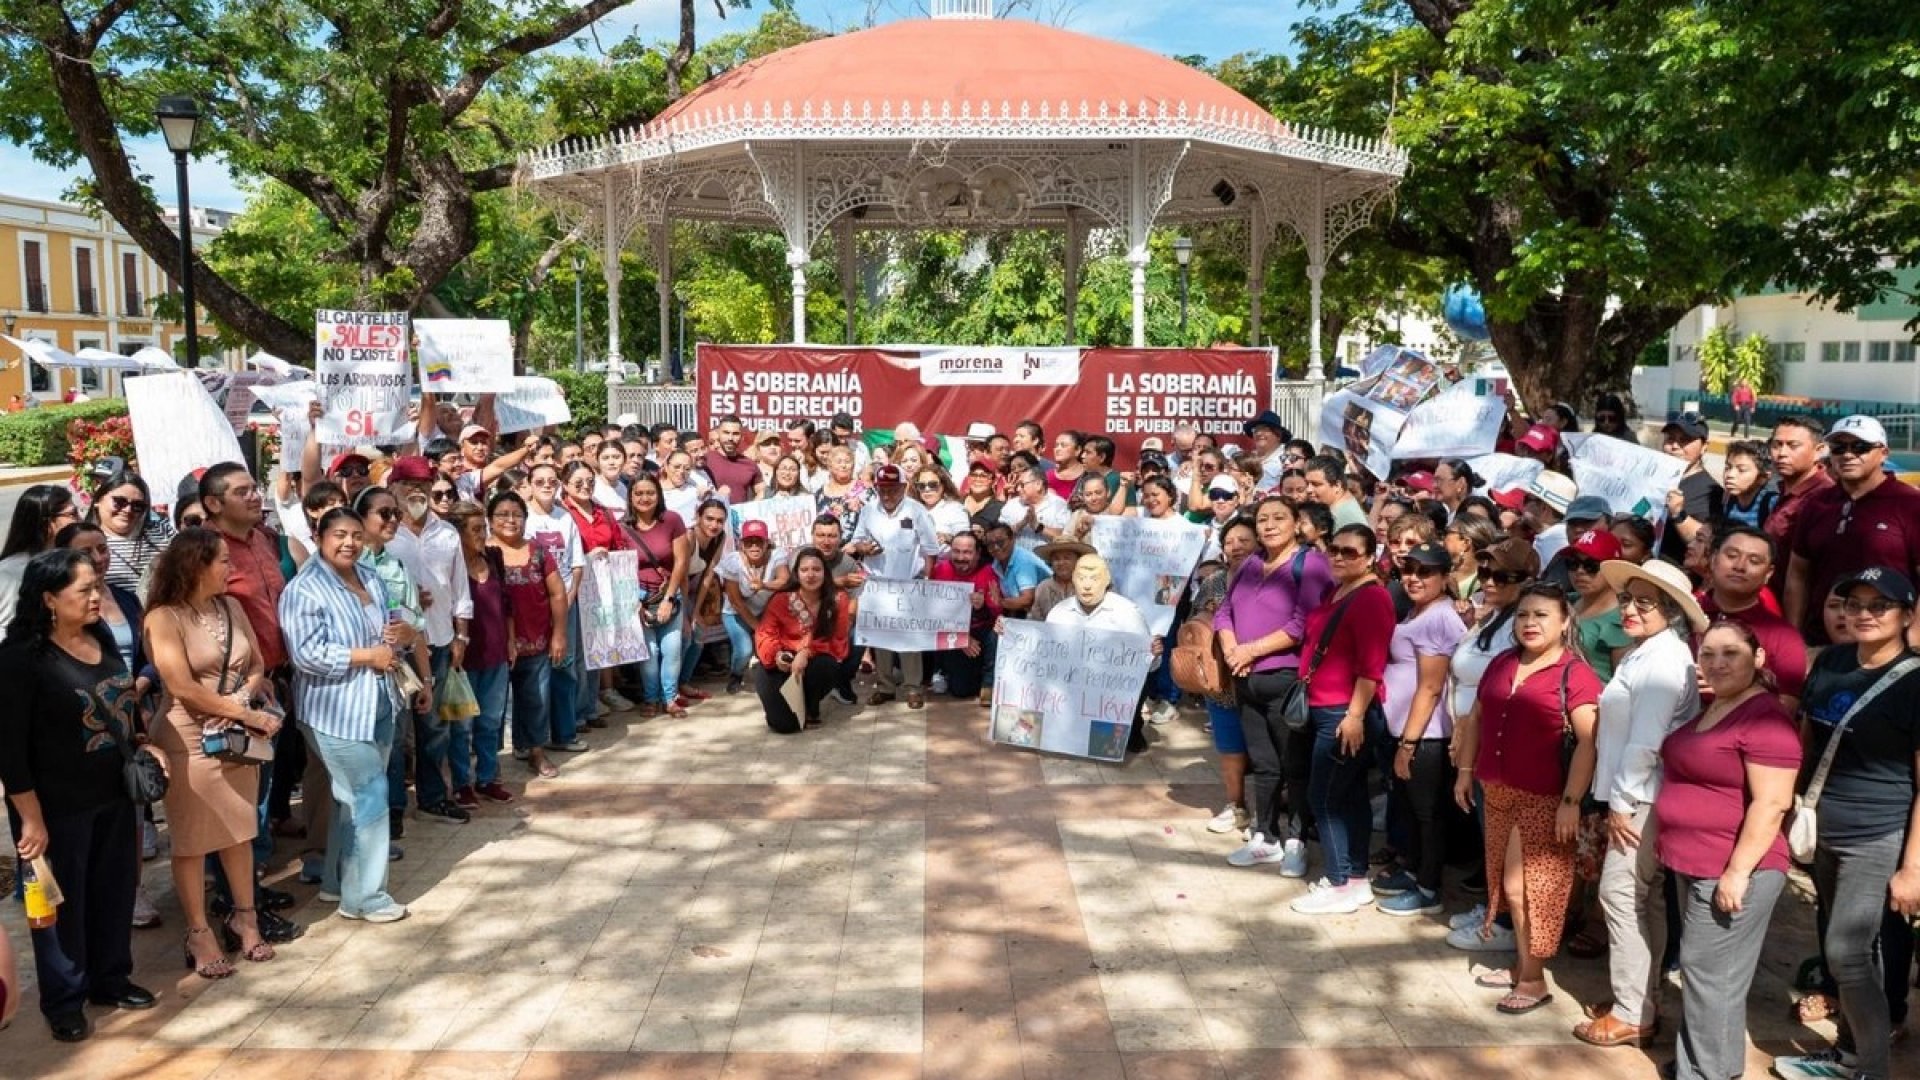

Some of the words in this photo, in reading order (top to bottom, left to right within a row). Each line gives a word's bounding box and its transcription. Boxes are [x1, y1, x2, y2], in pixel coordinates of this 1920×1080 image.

[333, 311, 386, 325] CARTEL
[323, 348, 344, 360] NO
[939, 357, 1003, 369] morena
[711, 371, 738, 392] LA
[743, 368, 862, 393] SOBERANÍA
[1106, 372, 1135, 393] LA
[1138, 369, 1257, 395] SOBERANÍA
[711, 393, 736, 414] ES
[740, 394, 764, 415] EL
[768, 395, 863, 416] DERECHO
[1106, 396, 1132, 417] ES
[1135, 396, 1160, 417] EL
[1164, 397, 1257, 418] DERECHO
[1105, 418, 1132, 433] DEL
